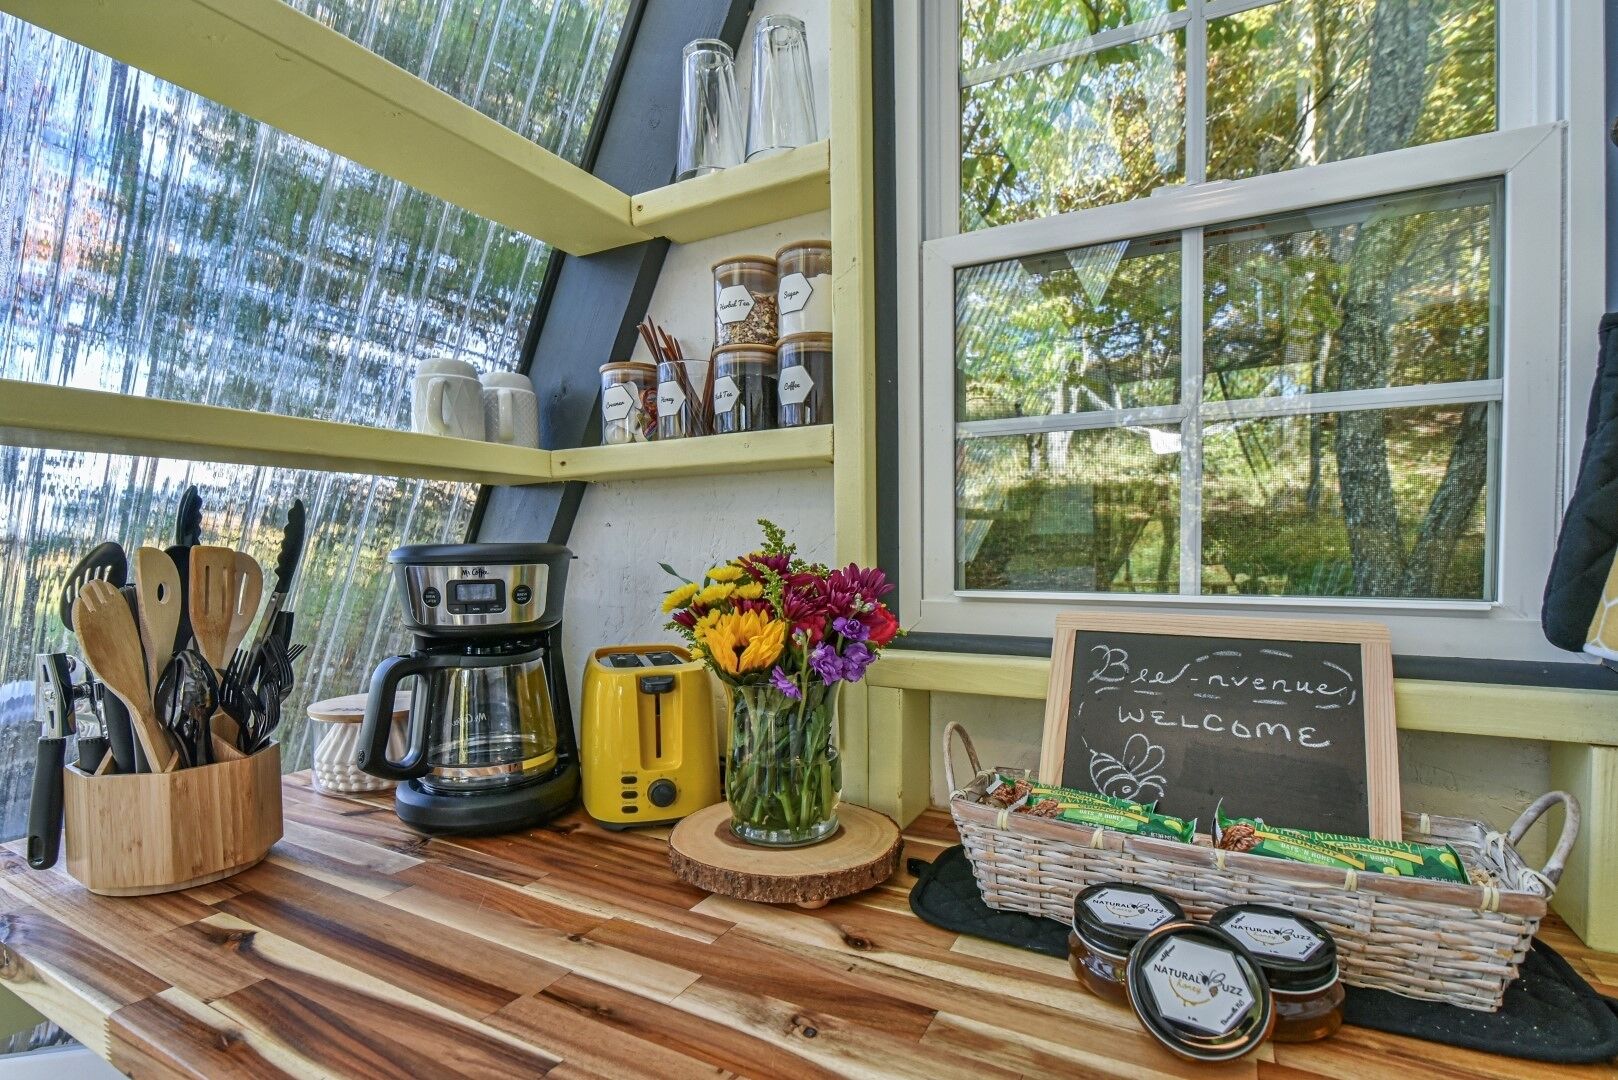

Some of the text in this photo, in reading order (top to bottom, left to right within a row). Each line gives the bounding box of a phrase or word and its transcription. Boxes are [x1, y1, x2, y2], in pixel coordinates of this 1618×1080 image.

[783, 290, 800, 301] Sugar
[738, 299, 751, 307] Tea
[783, 380, 801, 392] Coffee
[1117, 705, 1331, 748] WELCOME
[1260, 823, 1310, 841] NATURE
[1278, 834, 1339, 857] CRUNCHY
[1314, 830, 1364, 843] NATURE
[1366, 837, 1413, 854] VALLEY
[1334, 841, 1396, 855] CRUNCHY
[1311, 851, 1336, 864] HONEY
[1092, 898, 1130, 909] NATURAL
[1230, 923, 1273, 935] NATURAL
[1153, 963, 1201, 984] NATURAL
